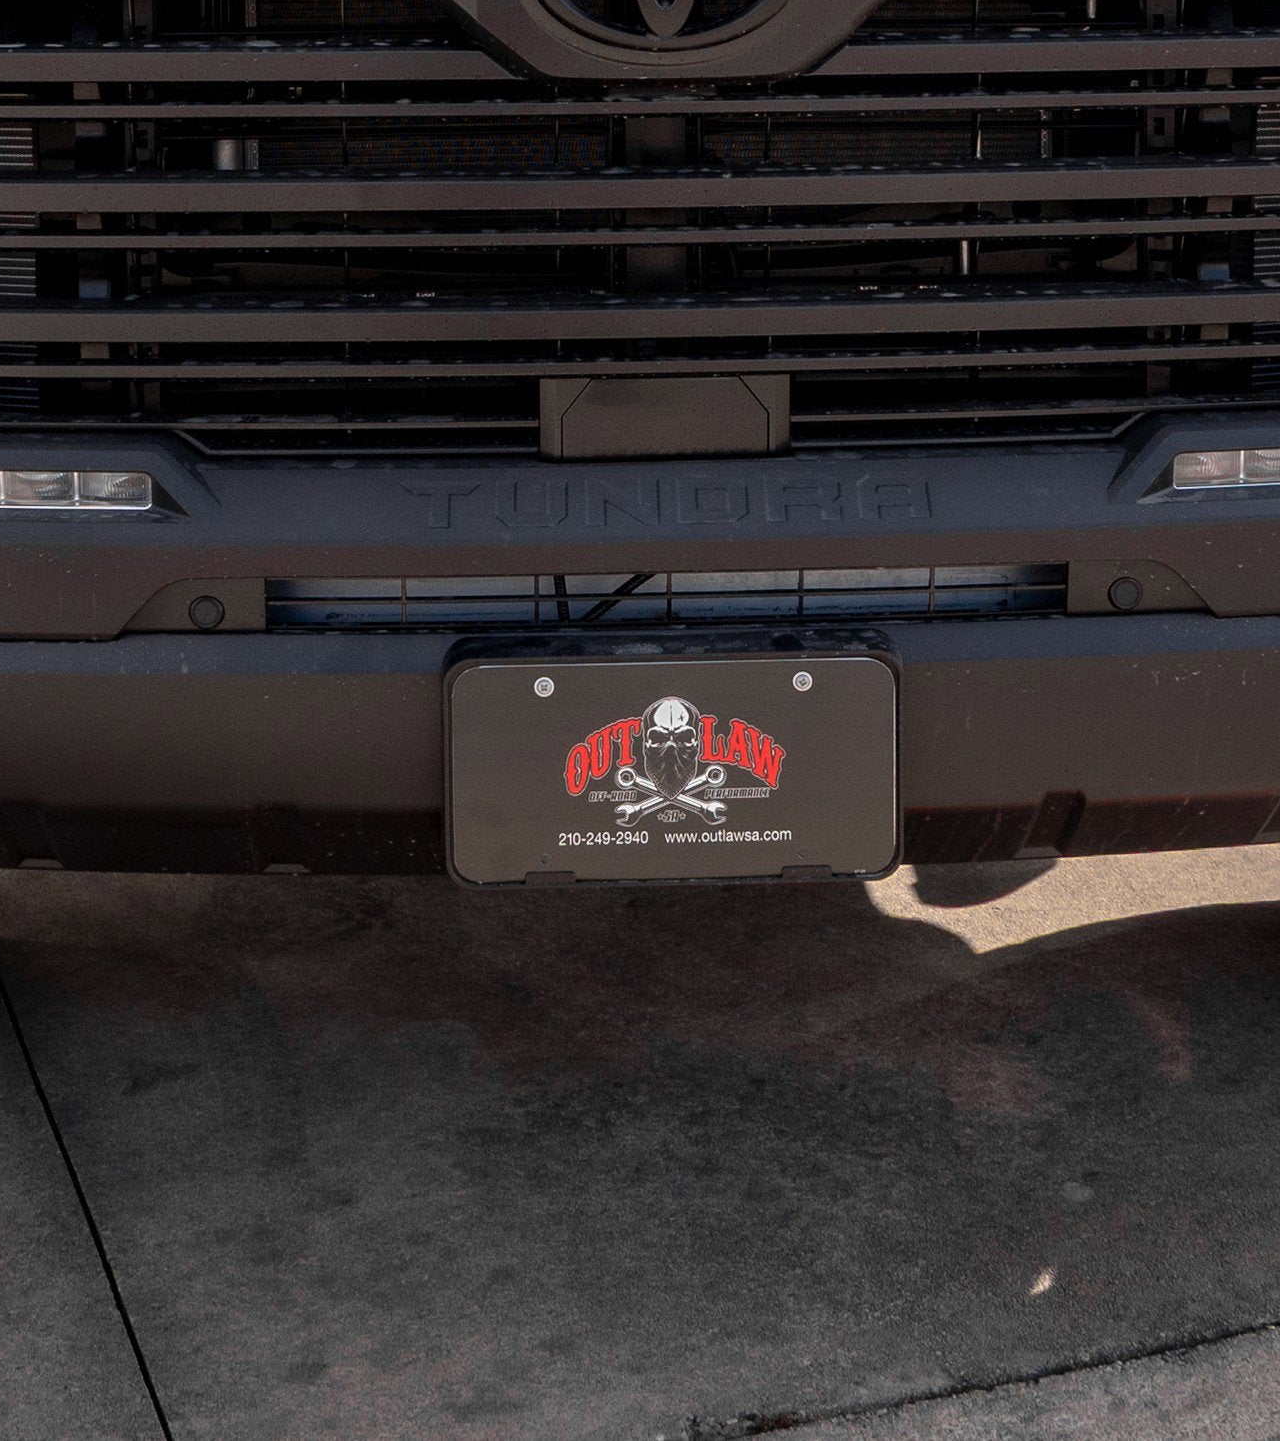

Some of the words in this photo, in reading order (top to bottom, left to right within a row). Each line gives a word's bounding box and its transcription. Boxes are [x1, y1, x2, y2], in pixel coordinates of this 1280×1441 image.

[401, 473, 933, 529] TUNDRA
[704, 787, 771, 800] PERFORMANCE
[558, 831, 649, 847] 210-249-2940
[664, 829, 793, 844] www.outlawsa.com
